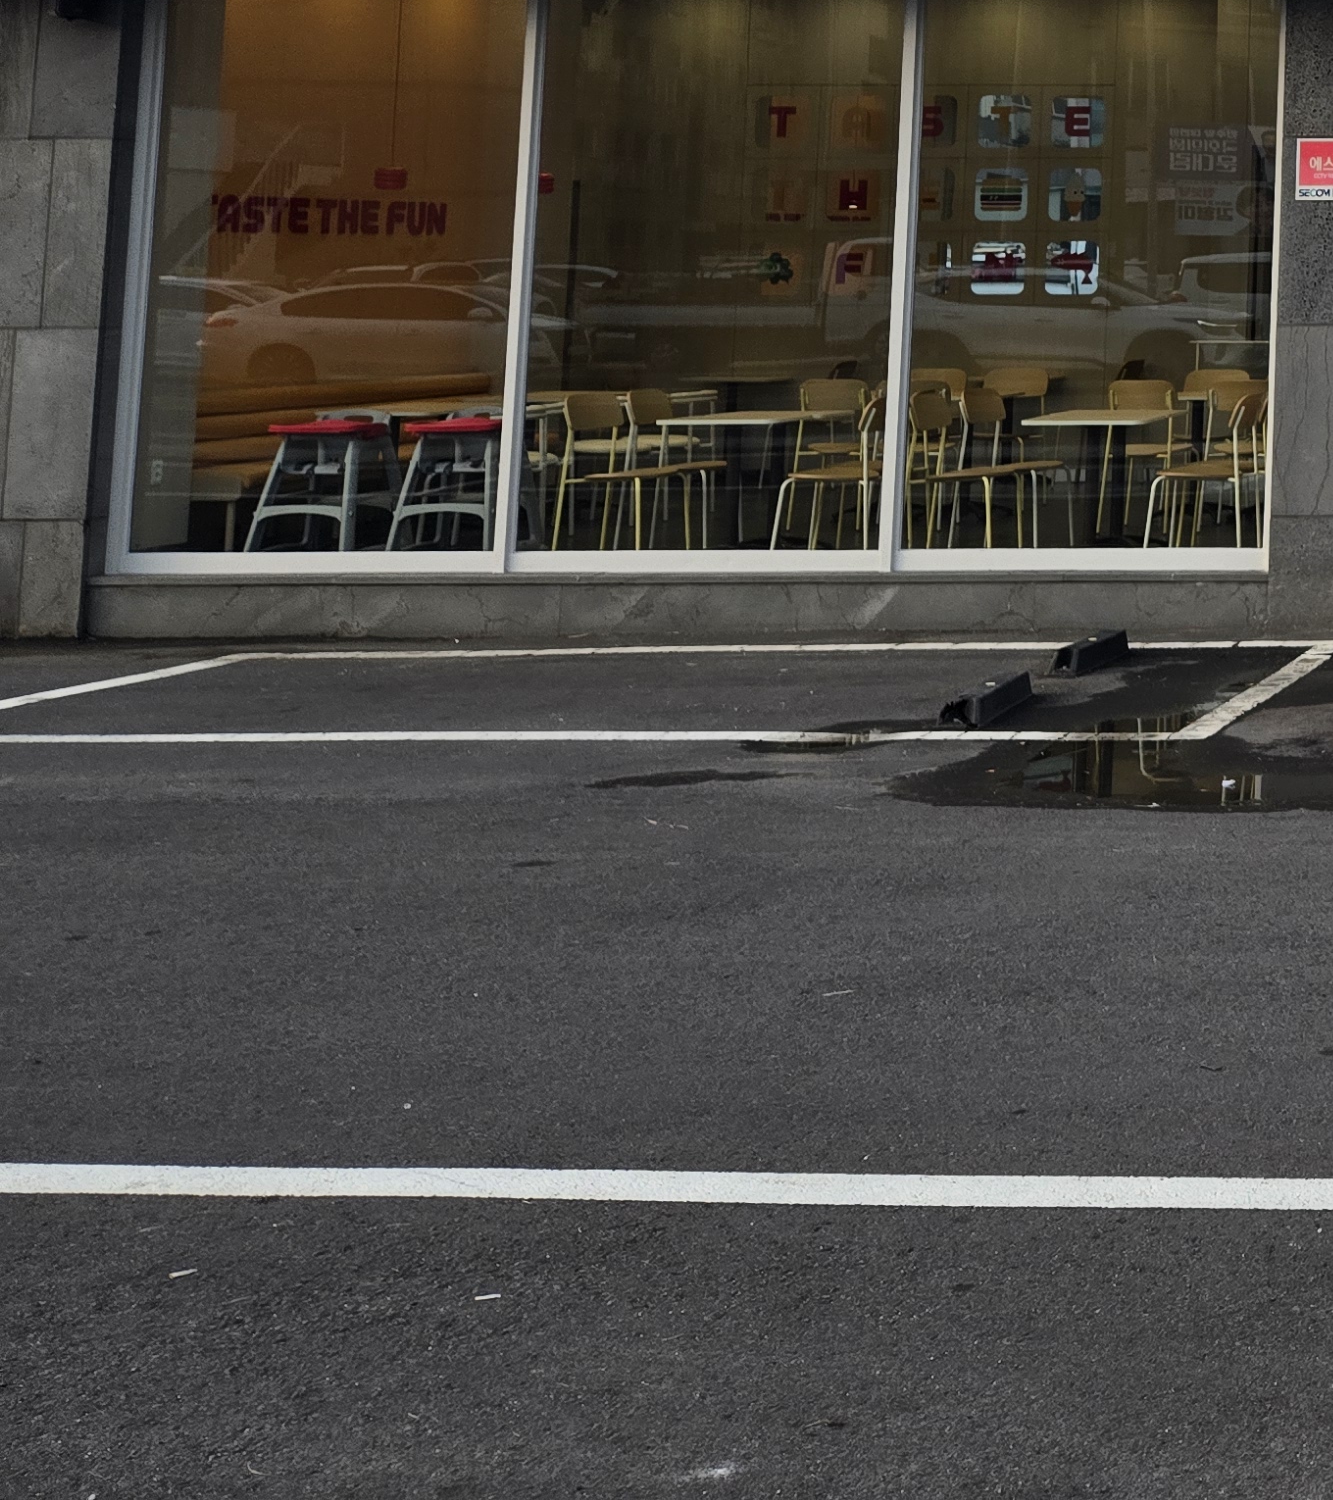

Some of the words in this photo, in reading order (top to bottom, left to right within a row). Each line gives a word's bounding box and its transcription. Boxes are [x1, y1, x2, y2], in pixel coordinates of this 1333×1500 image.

[1299, 188, 1331, 198] SECOM
[212, 193, 311, 234] ASTE
[316, 198, 381, 235] THE
[386, 200, 448, 237] FUN
